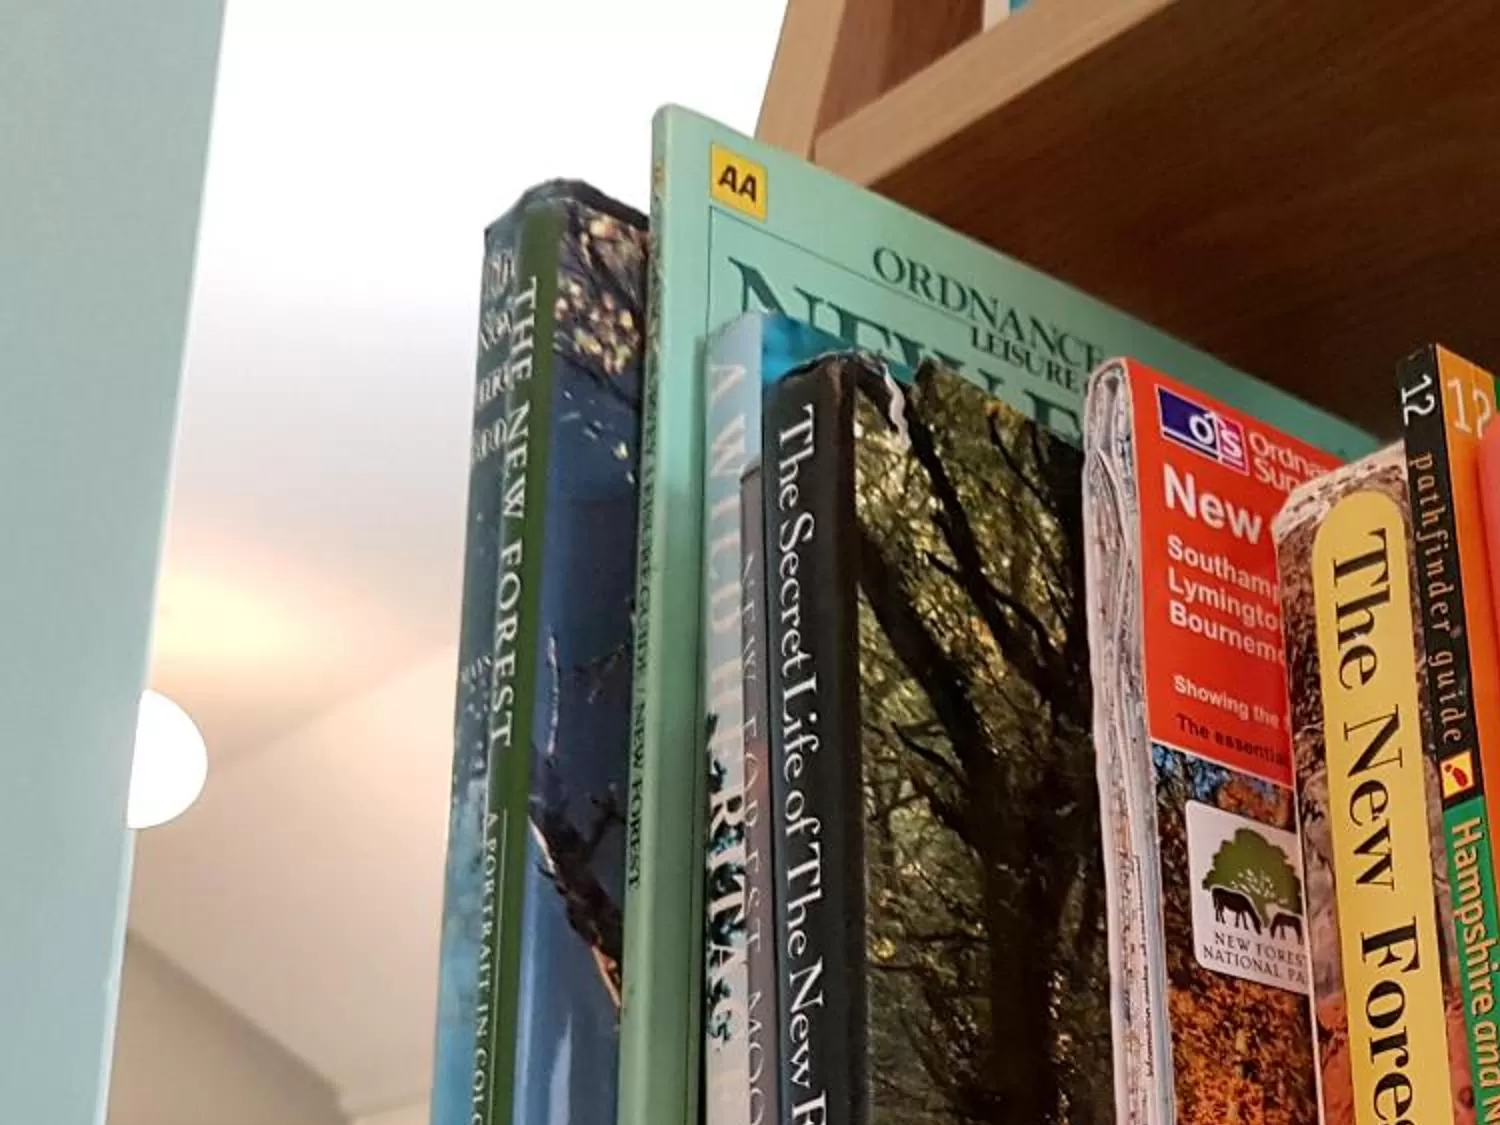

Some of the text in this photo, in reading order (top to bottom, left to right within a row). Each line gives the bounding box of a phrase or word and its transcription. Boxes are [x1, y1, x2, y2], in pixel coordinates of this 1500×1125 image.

[717, 164, 758, 202] AA
[970, 326, 1082, 393] LEISURE
[779, 403, 815, 511] The
[1163, 463, 1262, 545] New
[491, 275, 537, 748] THE NEW FOREST
[1401, 374, 1467, 745] 12 pathfinder guide
[779, 512, 815, 677] Secret
[1333, 527, 1391, 690] The
[782, 672, 820, 783] Life
[1173, 674, 1281, 726] Showing the
[1177, 713, 1210, 739] The
[785, 790, 821, 837] of
[1344, 704, 1403, 893] New
[478, 837, 497, 990] PORTRAIT
[786, 841, 823, 955] The
[1214, 932, 1251, 951] NEW
[1202, 944, 1282, 978] NATIONAL
[475, 1003, 489, 1037] IN
[789, 955, 825, 1089] New
